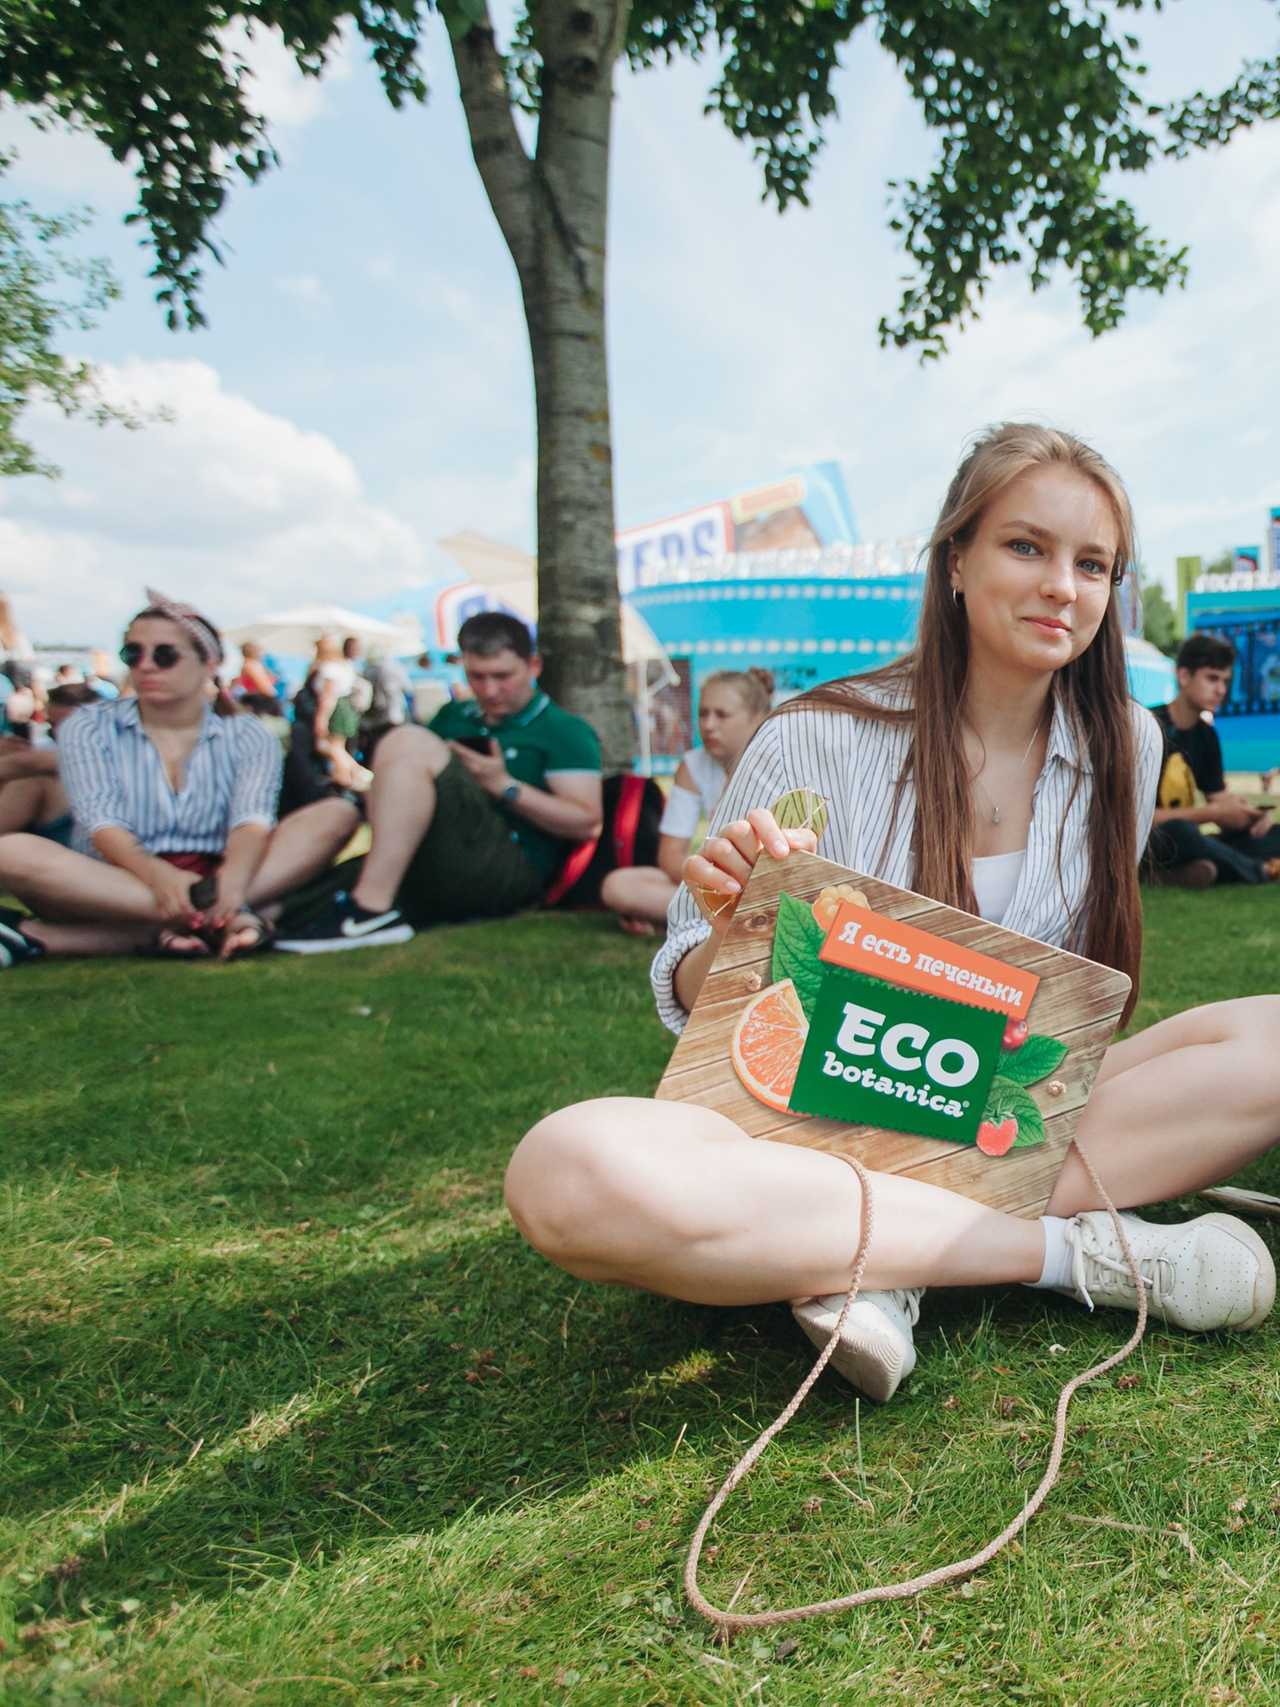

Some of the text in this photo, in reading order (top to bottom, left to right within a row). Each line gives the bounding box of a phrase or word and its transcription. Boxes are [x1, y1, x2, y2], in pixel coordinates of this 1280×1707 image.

[837, 920, 1023, 1008] Я есть печеньки
[821, 1049, 965, 1119] botanica
[835, 1000, 980, 1088] ECO
